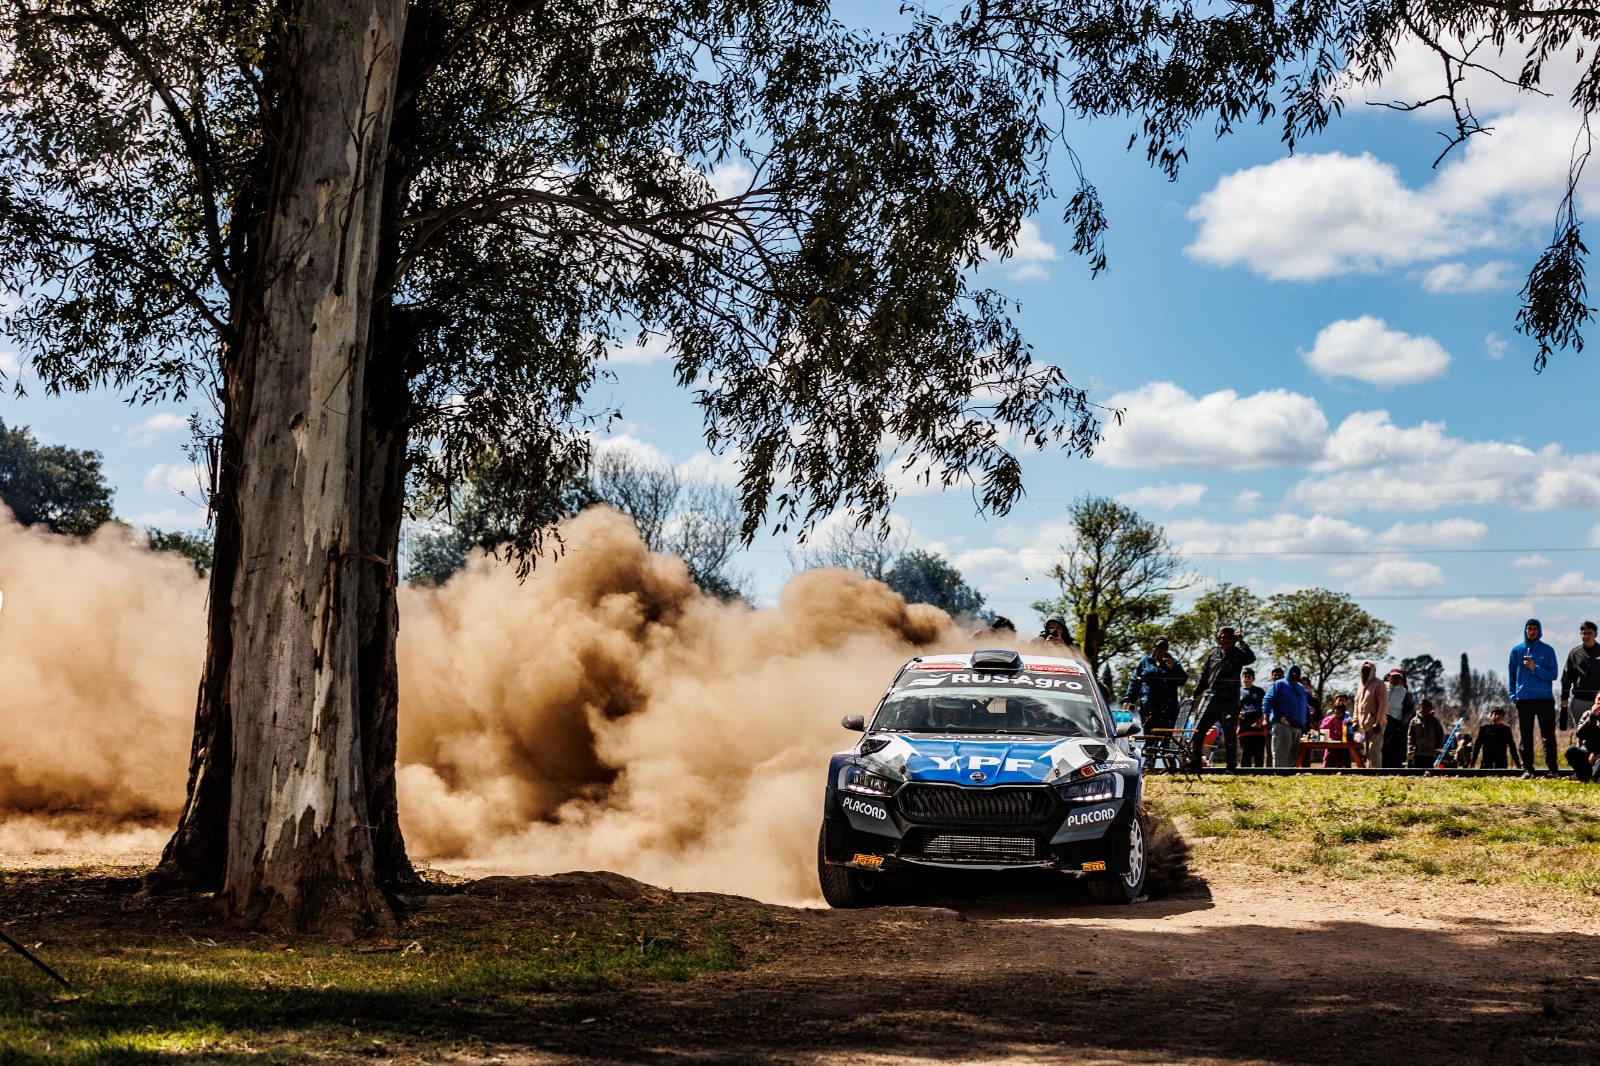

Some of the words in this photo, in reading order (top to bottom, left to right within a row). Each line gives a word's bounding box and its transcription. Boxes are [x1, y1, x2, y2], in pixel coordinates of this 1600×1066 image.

[928, 756, 1035, 772] YPF
[842, 796, 887, 820] PLACORD
[1067, 807, 1115, 827] PLACORD
